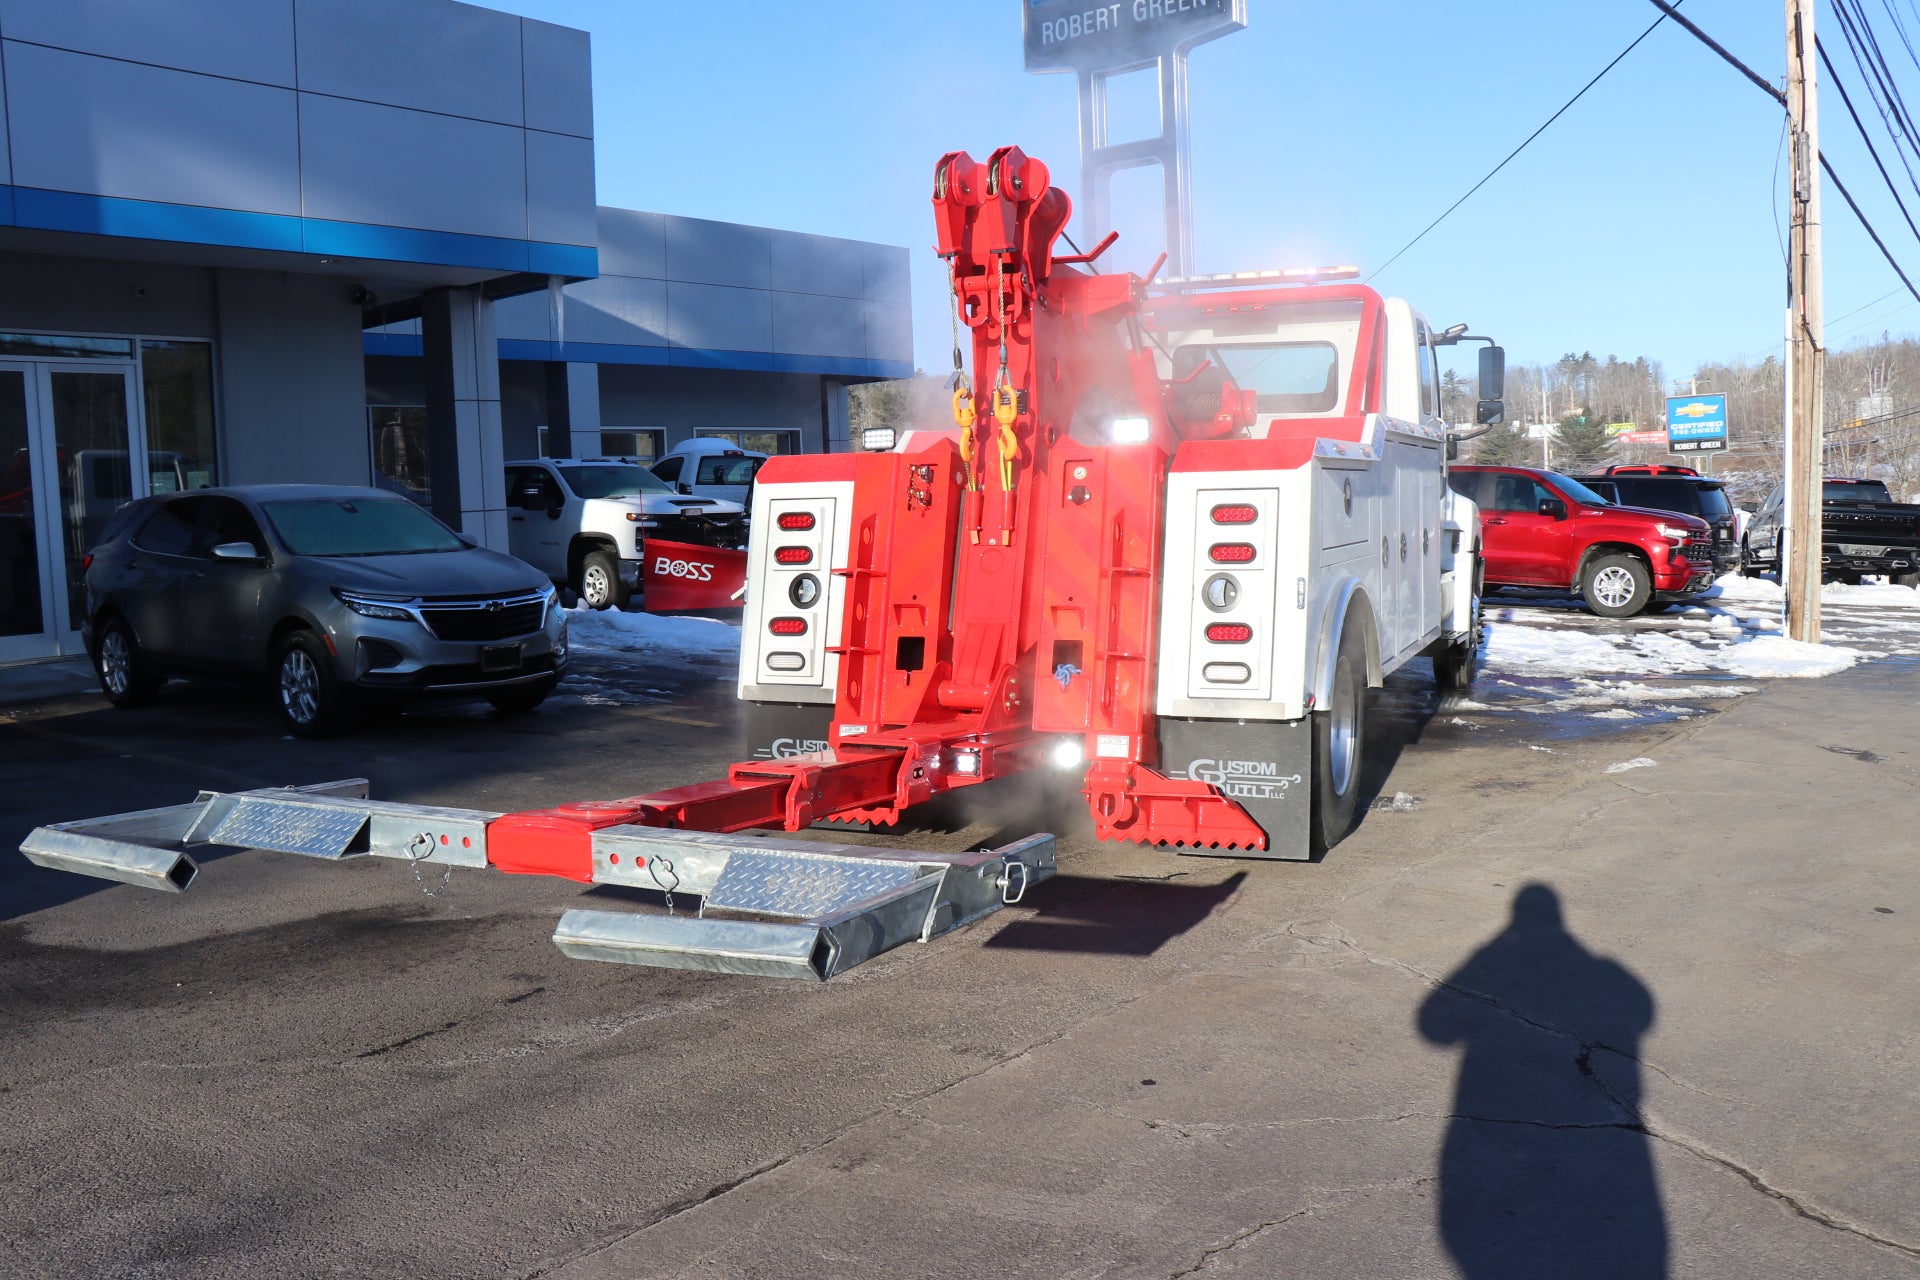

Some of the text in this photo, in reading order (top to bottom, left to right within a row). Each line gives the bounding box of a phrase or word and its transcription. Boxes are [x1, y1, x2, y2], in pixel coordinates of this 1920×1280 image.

[1041, 4, 1121, 45] ROBERT
[1670, 420, 1724, 430] CERTIFIED
[1673, 426, 1721, 436] PRE-OWNED
[1674, 440, 1721, 451] ROBERT GREEN
[654, 556, 715, 582] BOSS
[771, 737, 831, 759] CUSTO
[1188, 758, 1277, 782] CUSTOM
[1270, 791, 1285, 800] LLC
